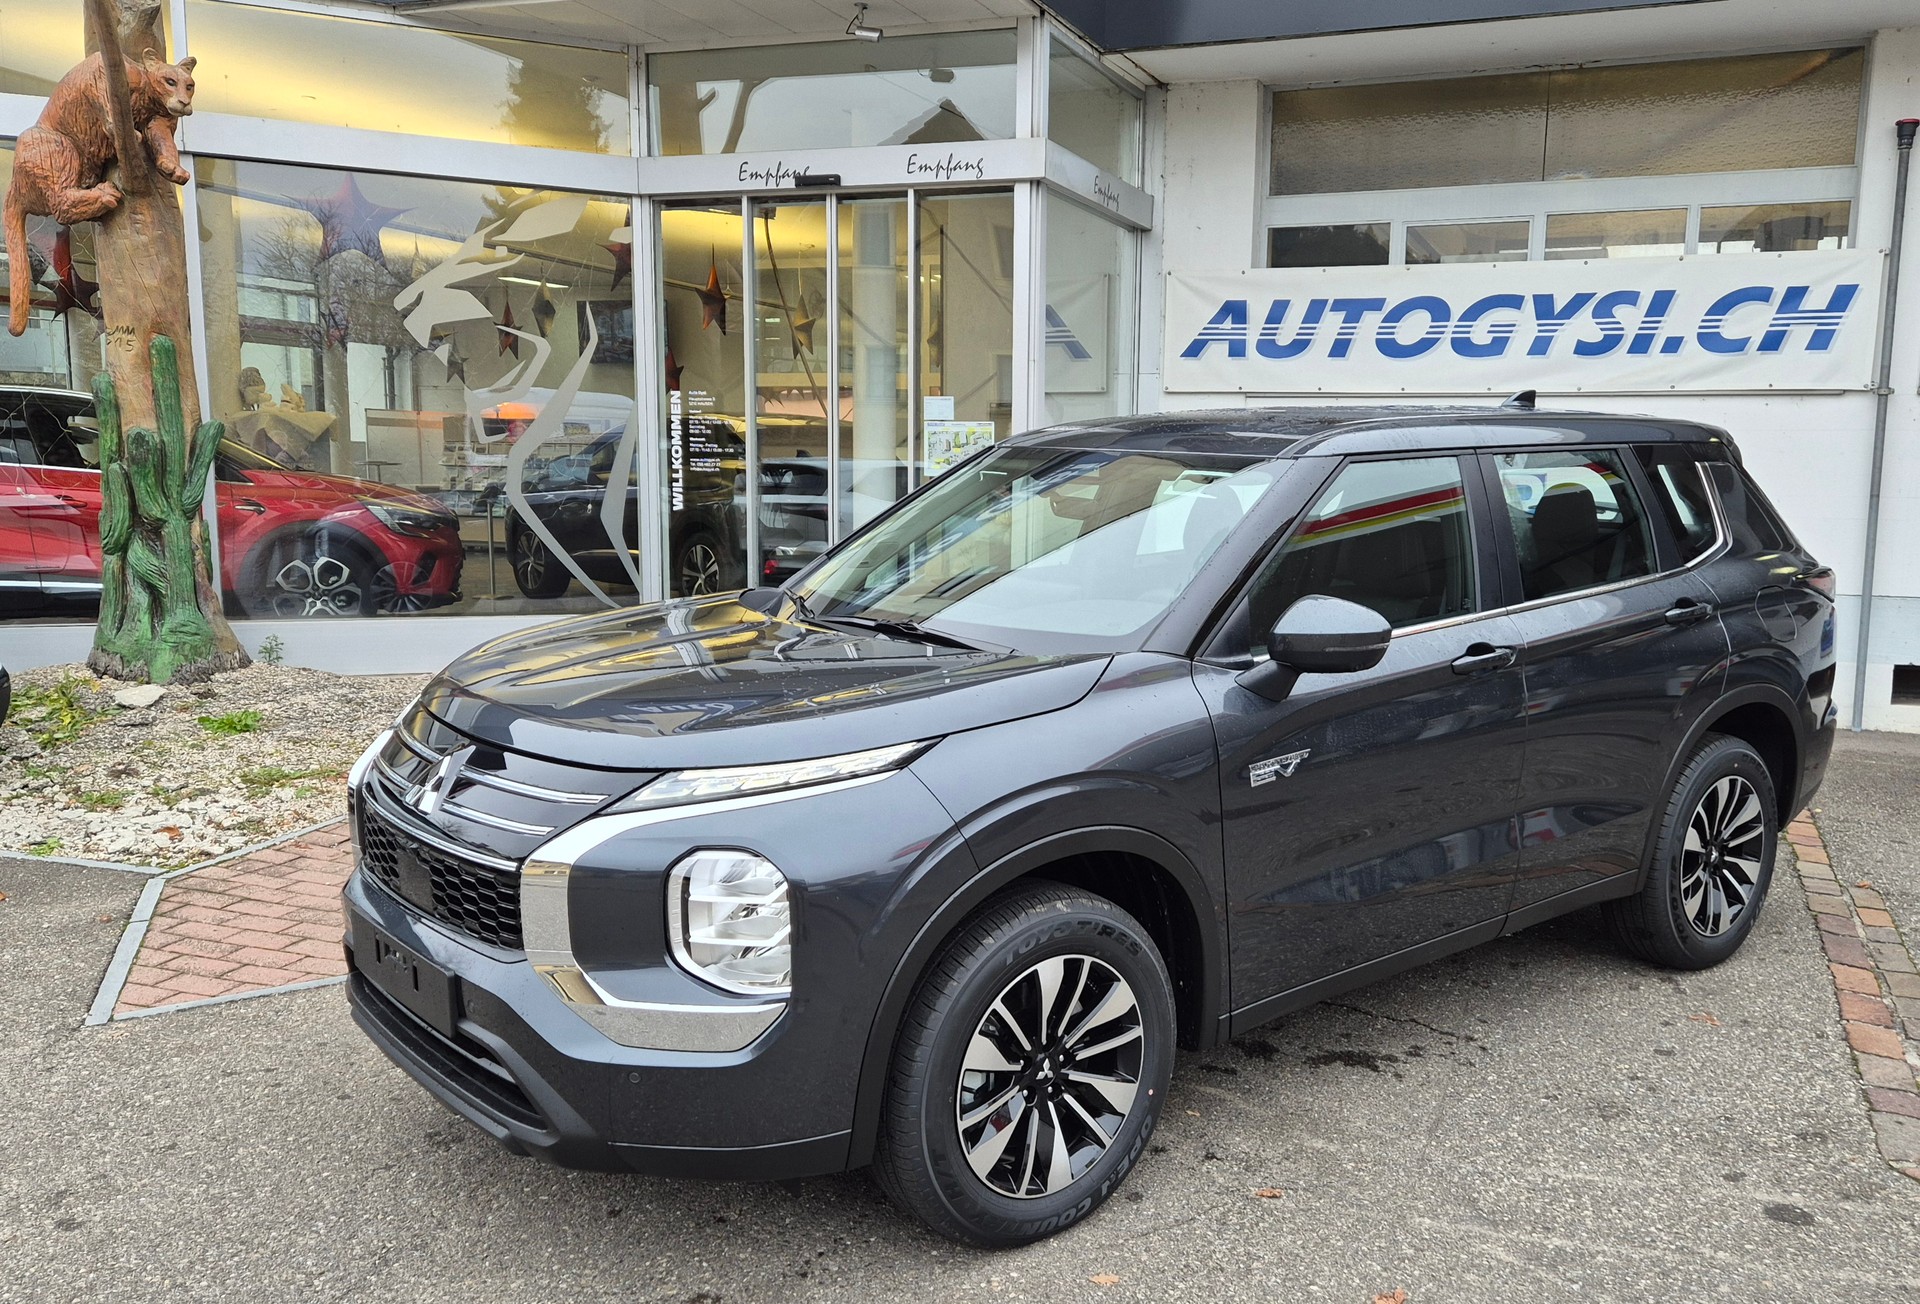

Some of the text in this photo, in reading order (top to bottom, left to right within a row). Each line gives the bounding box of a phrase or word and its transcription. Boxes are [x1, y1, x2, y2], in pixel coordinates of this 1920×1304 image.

[906, 152, 985, 180] Empfang
[1093, 175, 1120, 212] Empfang
[1179, 283, 1861, 361] AUTOGYSI.CH
[670, 390, 684, 511] WILLKOMMEN
[1249, 759, 1301, 788] EV
[1001, 920, 1074, 966] TOYO
